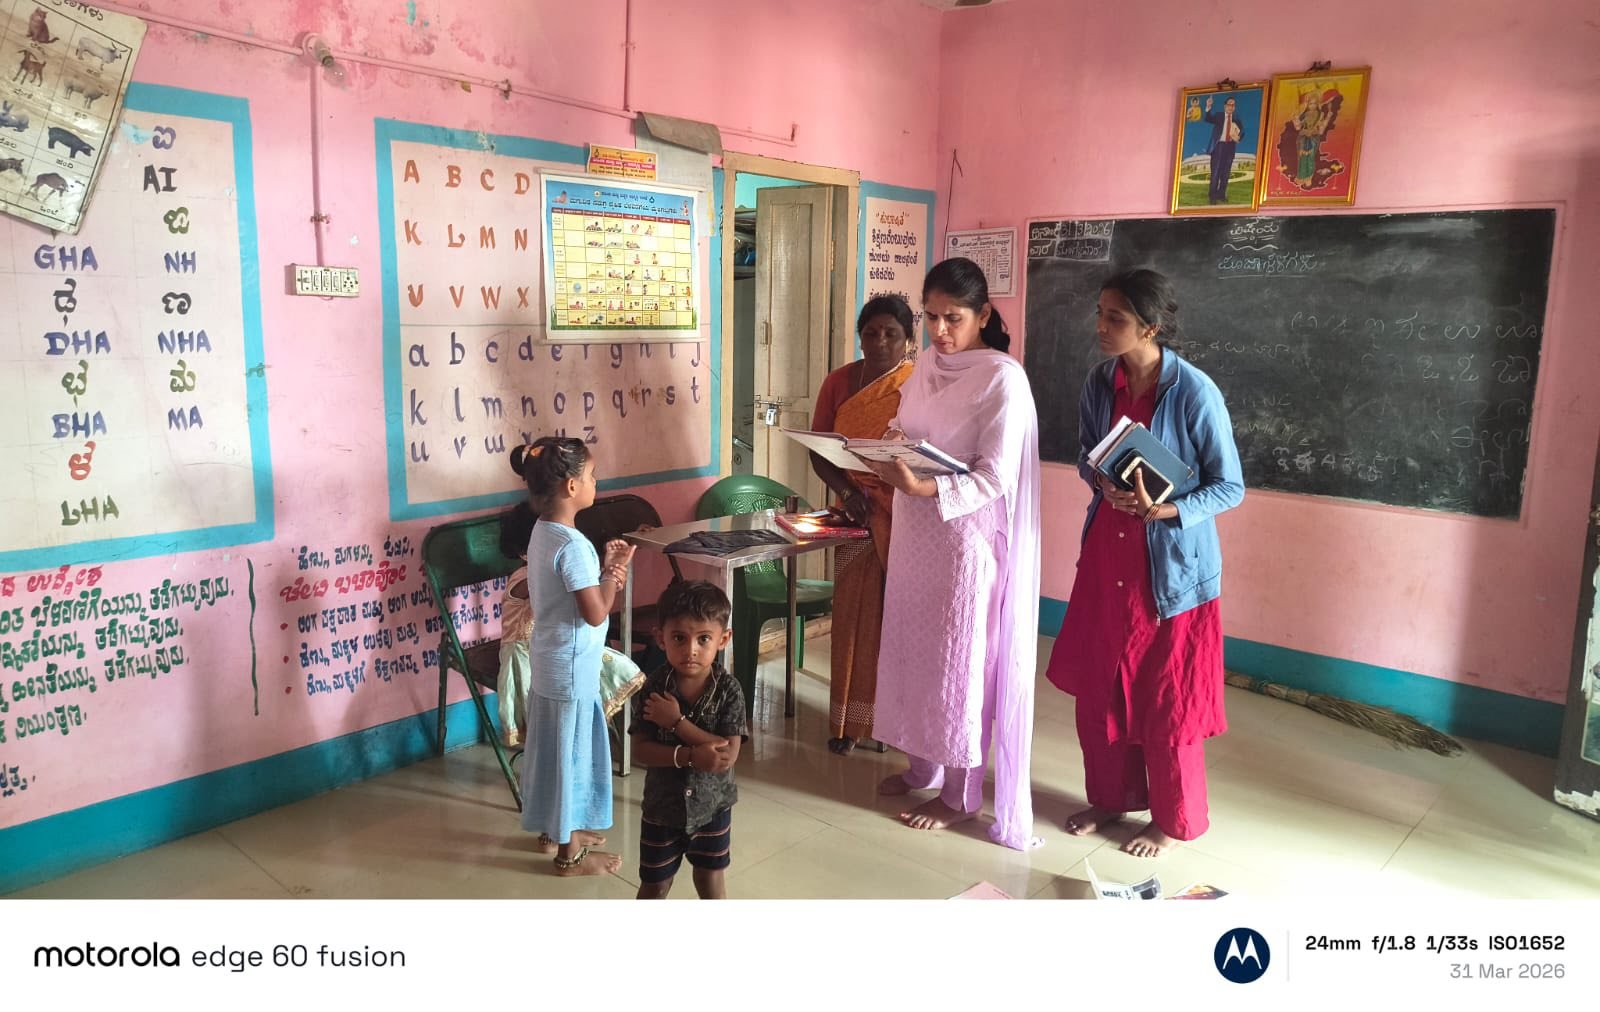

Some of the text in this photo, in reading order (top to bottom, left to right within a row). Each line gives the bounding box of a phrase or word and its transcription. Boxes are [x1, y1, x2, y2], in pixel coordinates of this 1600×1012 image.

[152, 126, 176, 150] ಐ
[143, 164, 177, 194] AI
[404, 160, 530, 195] A B C D
[404, 219, 528, 251] K L M N
[34, 244, 196, 274] GHA NH
[162, 292, 191, 315] ಣ
[407, 284, 529, 310] U V W X
[43, 329, 212, 355] DHA NHA
[409, 344, 430, 367] a
[449, 332, 465, 365] b
[485, 340, 498, 363] c
[518, 332, 534, 361] d
[551, 344, 563, 361] e
[610, 344, 622, 368] g
[170, 359, 196, 392] ಮ
[410, 376, 700, 426] k l m n o p q r s t
[52, 405, 203, 439] BHA MA
[411, 440, 429, 463] u
[454, 435, 467, 460] v
[485, 434, 505, 454] w
[583, 426, 598, 445] z
[61, 495, 119, 526] LHA
[298, 546, 330, 570] ಹೆಣ್ಣು
[0, 629, 86, 672] ಷ್ಟಿಕತೆಯನ್ನು
